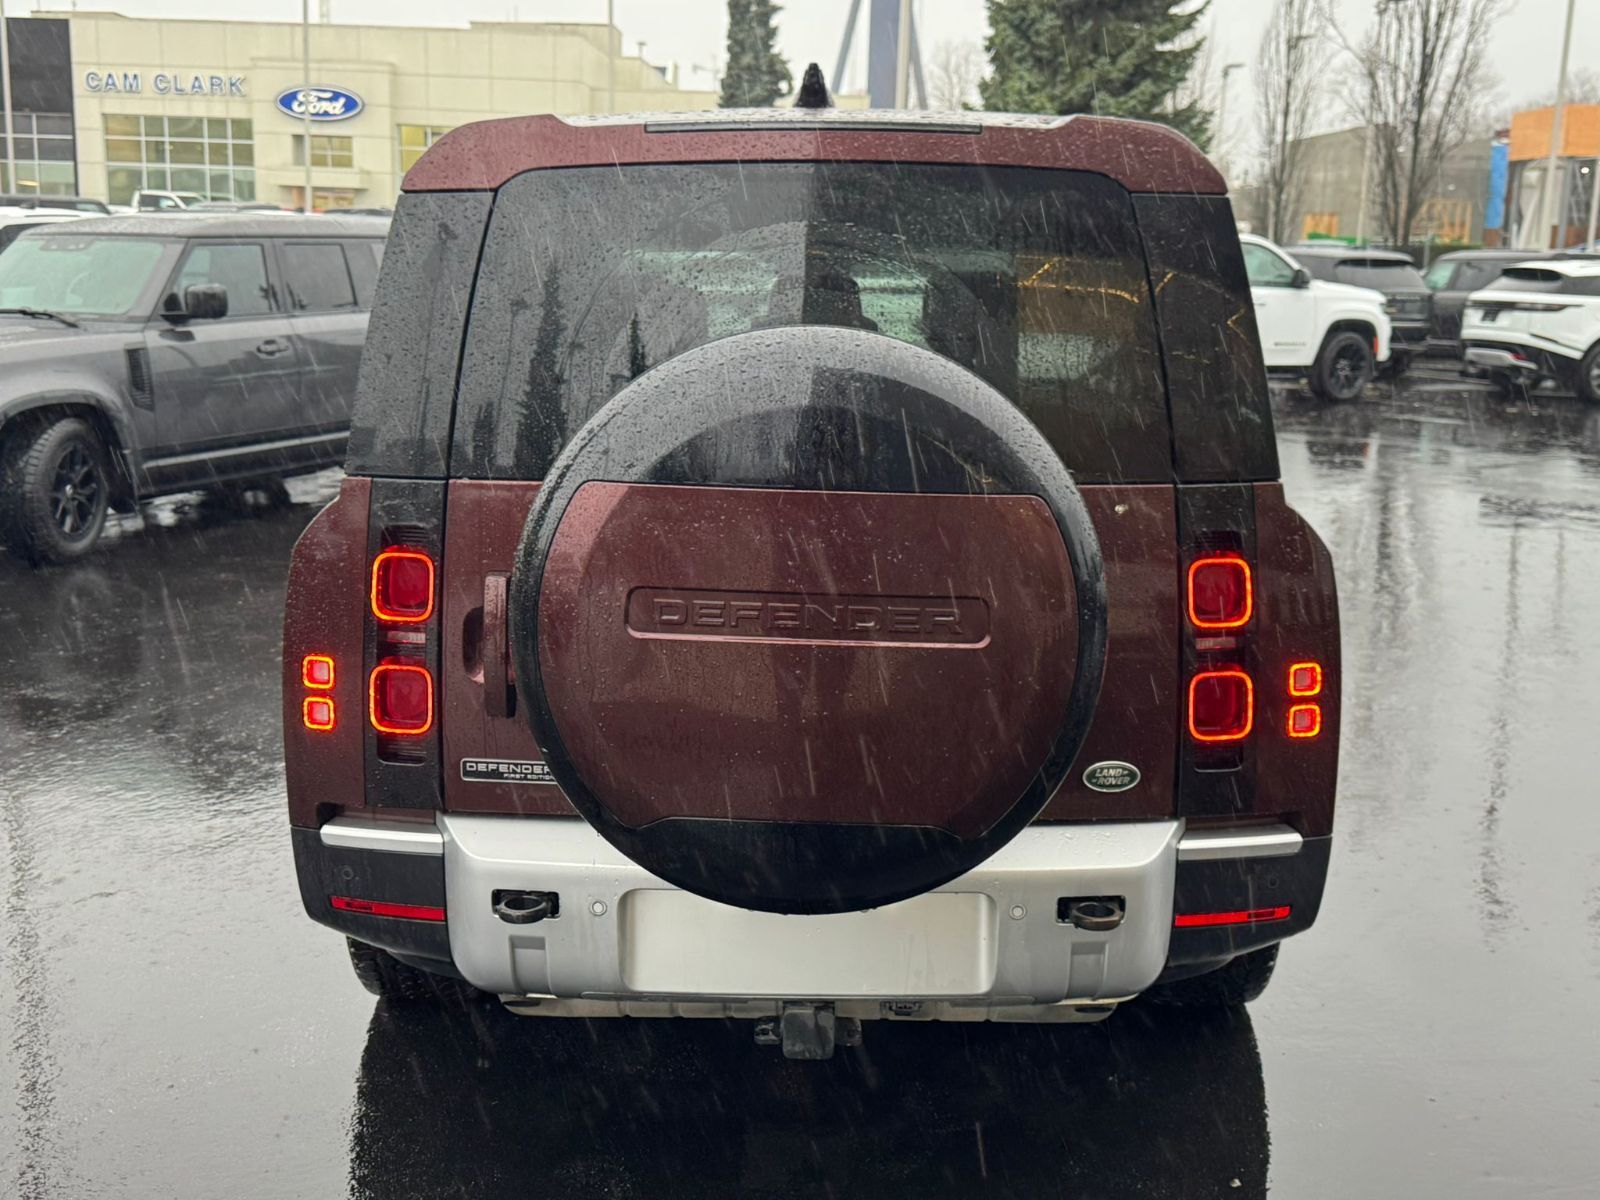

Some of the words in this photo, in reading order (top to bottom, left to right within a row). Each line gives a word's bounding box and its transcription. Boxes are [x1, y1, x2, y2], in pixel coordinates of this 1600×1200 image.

[85, 72, 141, 93] CAM
[153, 74, 246, 96] CLARK
[291, 91, 347, 114] Ford
[652, 598, 964, 635] DEFENDER
[1095, 768, 1123, 777] LAND
[1097, 777, 1130, 785] ROVER
